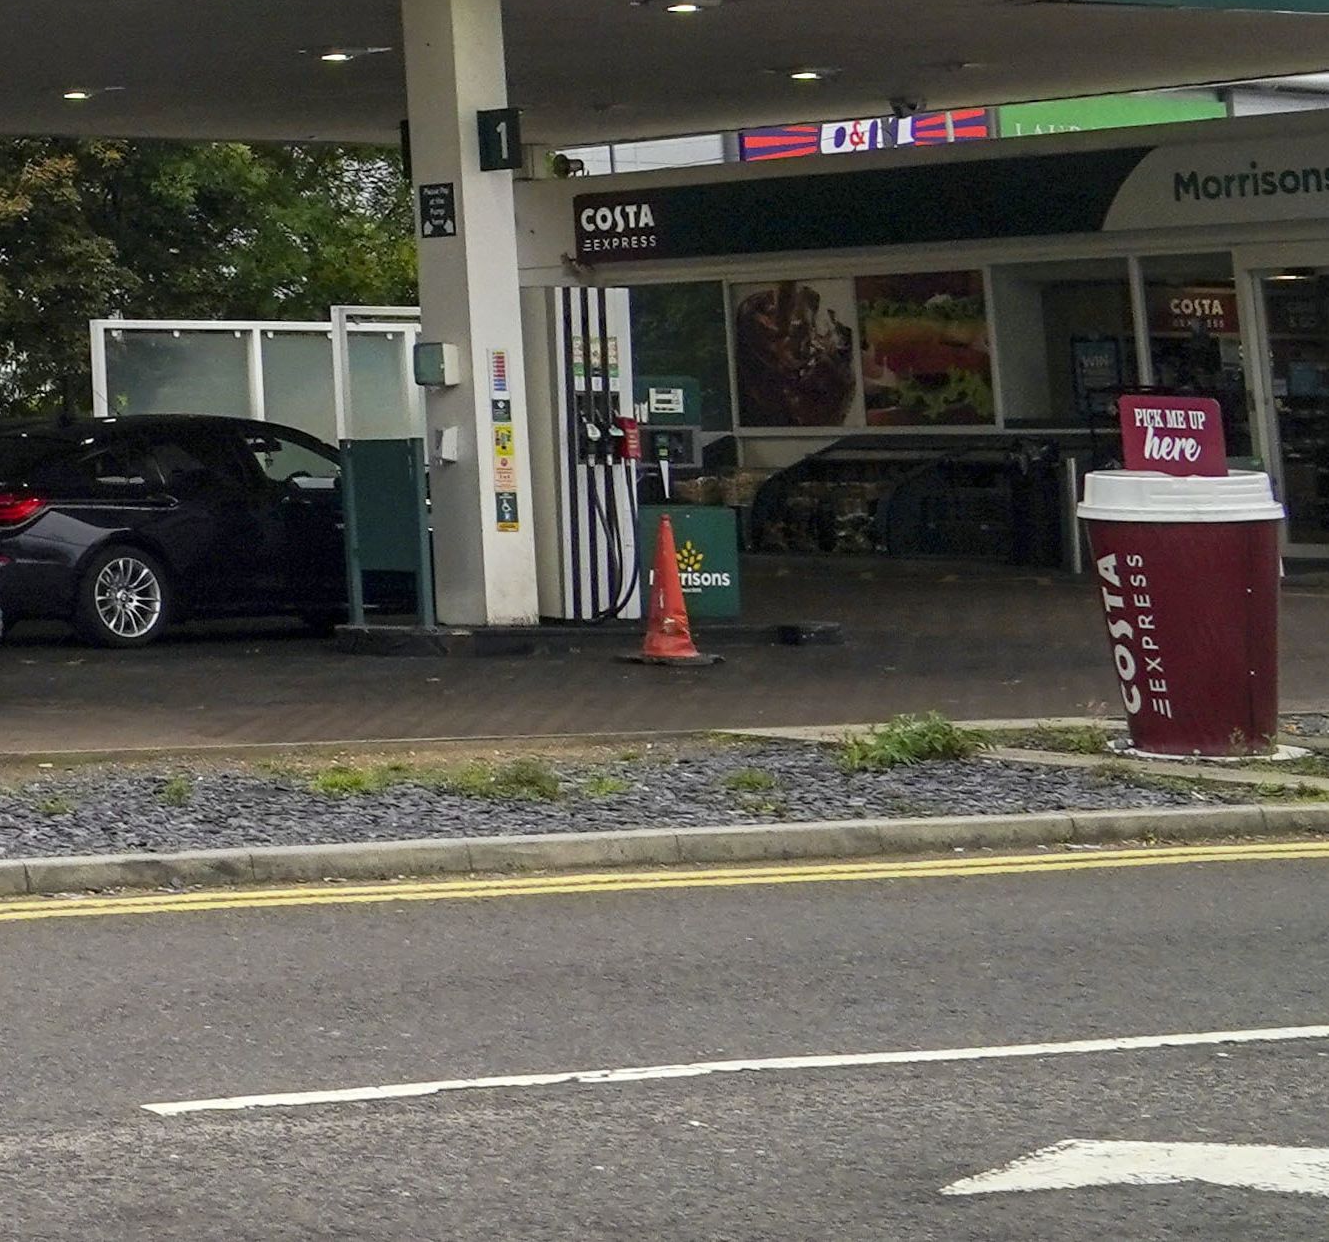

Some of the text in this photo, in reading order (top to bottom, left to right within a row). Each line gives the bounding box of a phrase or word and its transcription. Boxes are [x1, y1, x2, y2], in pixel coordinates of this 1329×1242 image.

[495, 121, 509, 159] 1
[581, 204, 655, 233] COSTA
[593, 235, 657, 251] EXPRESS
[1170, 299, 1223, 316] COSTA
[1134, 408, 1206, 430] PICK ME UP
[1144, 425, 1202, 462] here
[649, 567, 731, 586] risons
[1097, 553, 1141, 714] COSTA
[1127, 554, 1169, 692] EXPRESS
